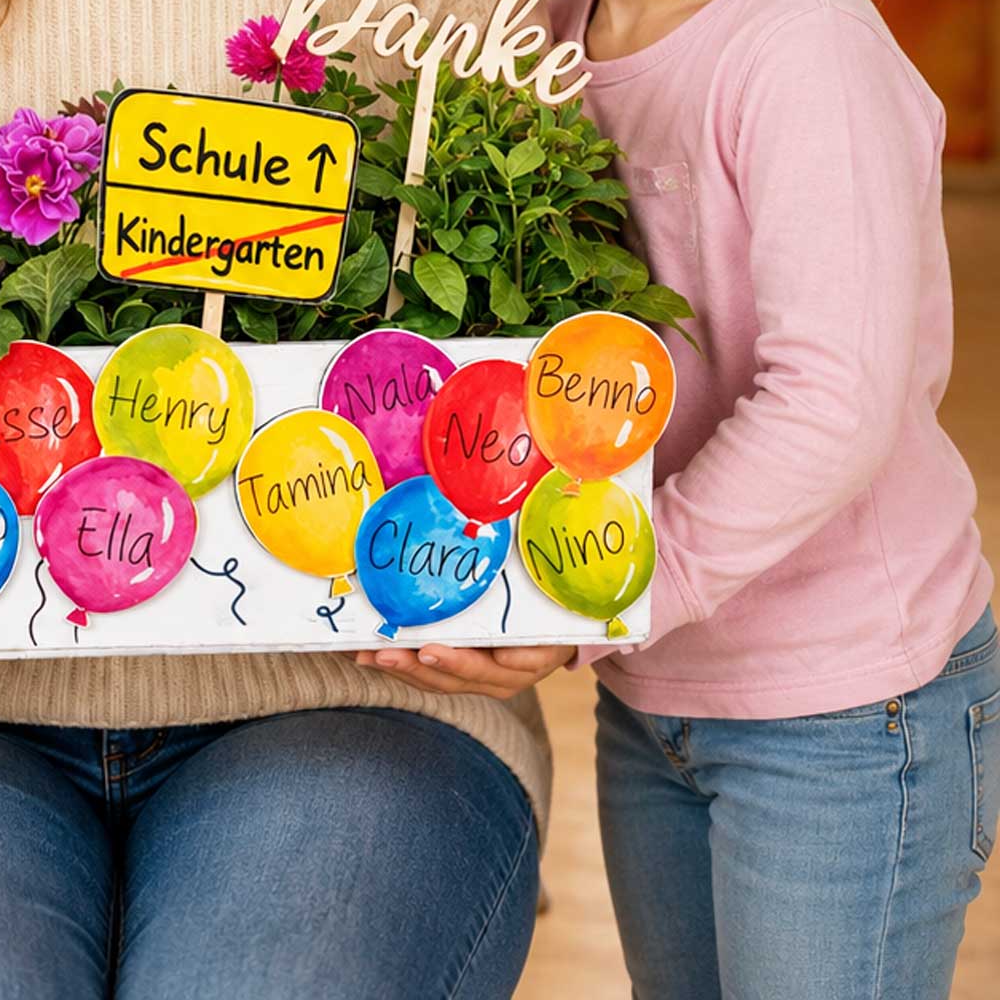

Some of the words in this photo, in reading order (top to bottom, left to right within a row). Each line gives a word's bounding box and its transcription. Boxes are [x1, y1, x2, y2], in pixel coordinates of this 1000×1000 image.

[138, 122, 290, 185] Schule
[116, 212, 325, 276] Kindergarten
[109, 376, 230, 445] Henry
[344, 366, 438, 421] Nala
[537, 353, 656, 415] Benno
[444, 413, 532, 467] Neo
[238, 459, 371, 517] Tamina
[77, 507, 155, 567] Ella
[369, 520, 481, 583] Clara
[527, 521, 625, 581] Nino
